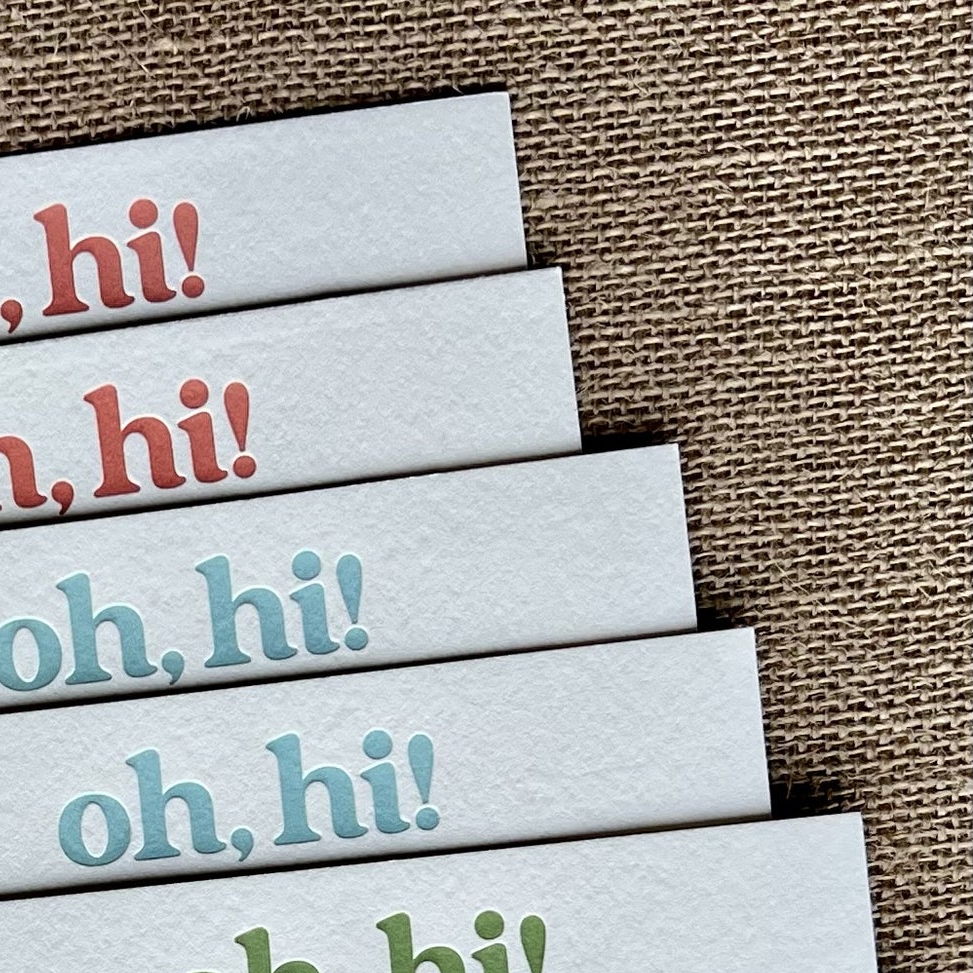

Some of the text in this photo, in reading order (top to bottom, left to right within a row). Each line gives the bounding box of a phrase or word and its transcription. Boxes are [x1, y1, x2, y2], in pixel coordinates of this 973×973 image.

[33, 198, 206, 317] hi!
[83, 378, 257, 498] hi!
[196, 550, 369, 669] hi!
[58, 729, 440, 867] oh, hi!
